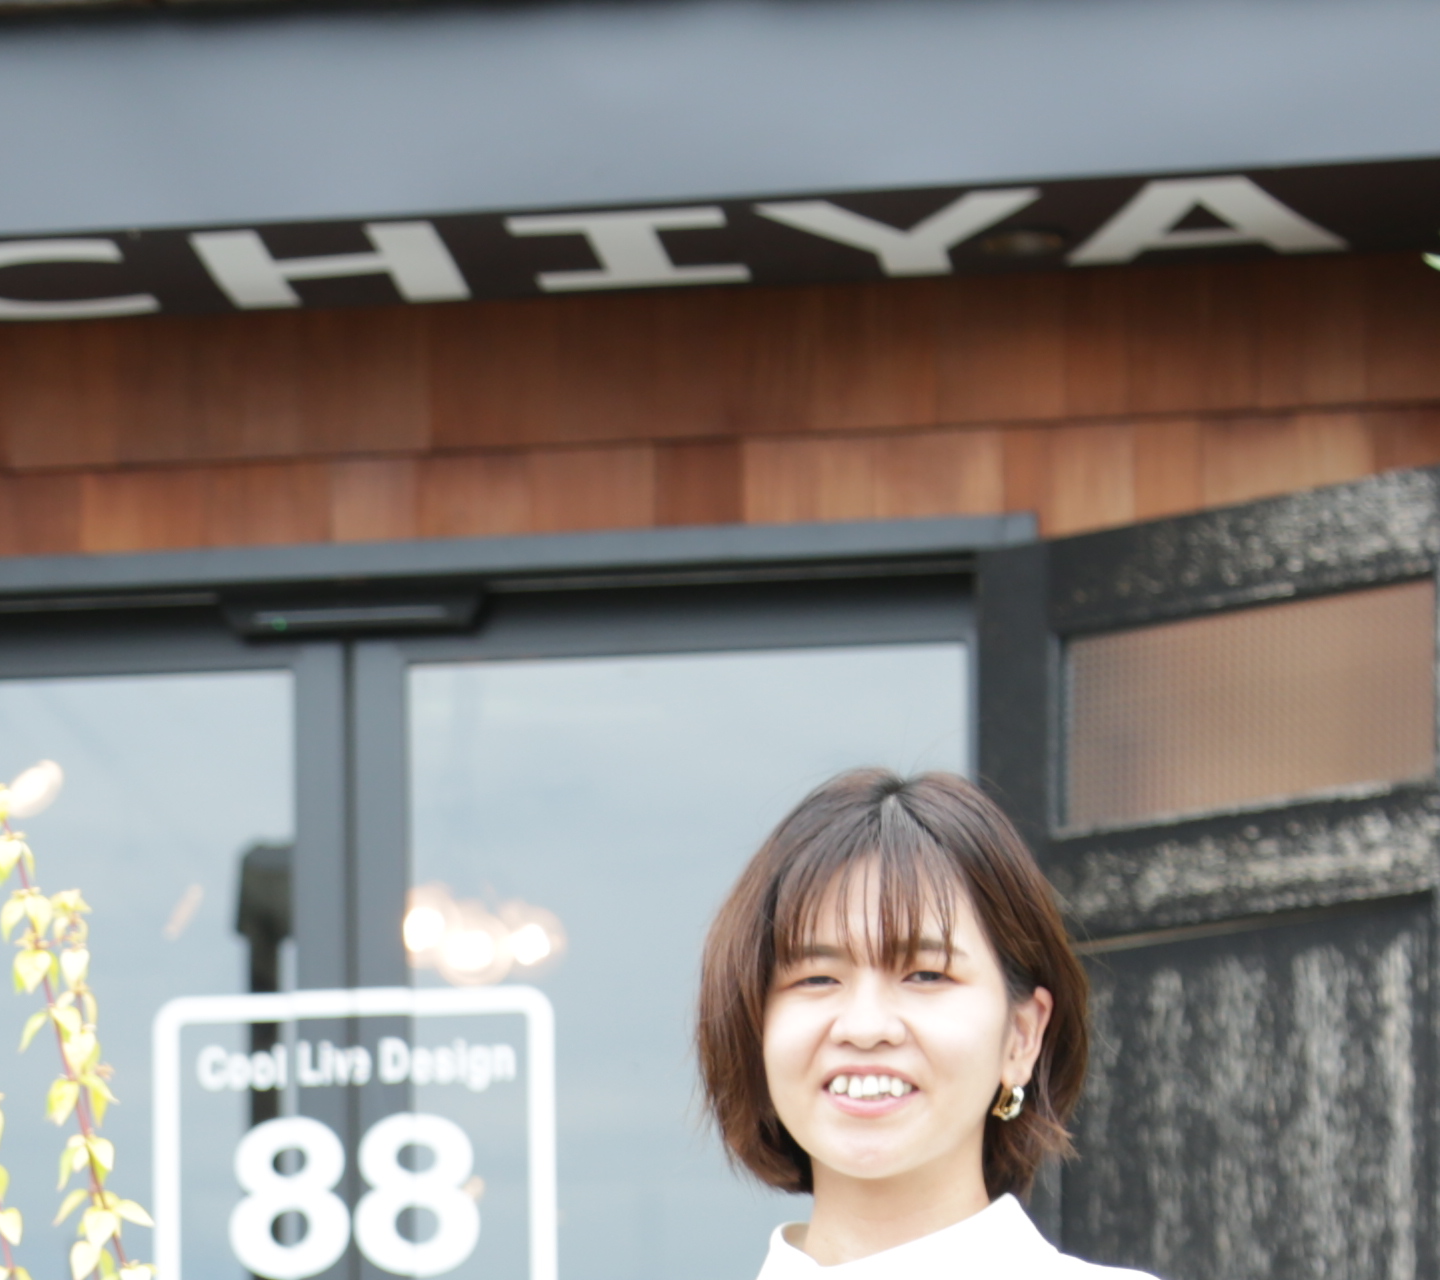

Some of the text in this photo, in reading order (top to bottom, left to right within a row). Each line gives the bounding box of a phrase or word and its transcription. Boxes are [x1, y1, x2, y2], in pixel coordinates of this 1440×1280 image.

[196, 1036, 518, 1092] Cool Live Design
[229, 1112, 480, 1280] 88
